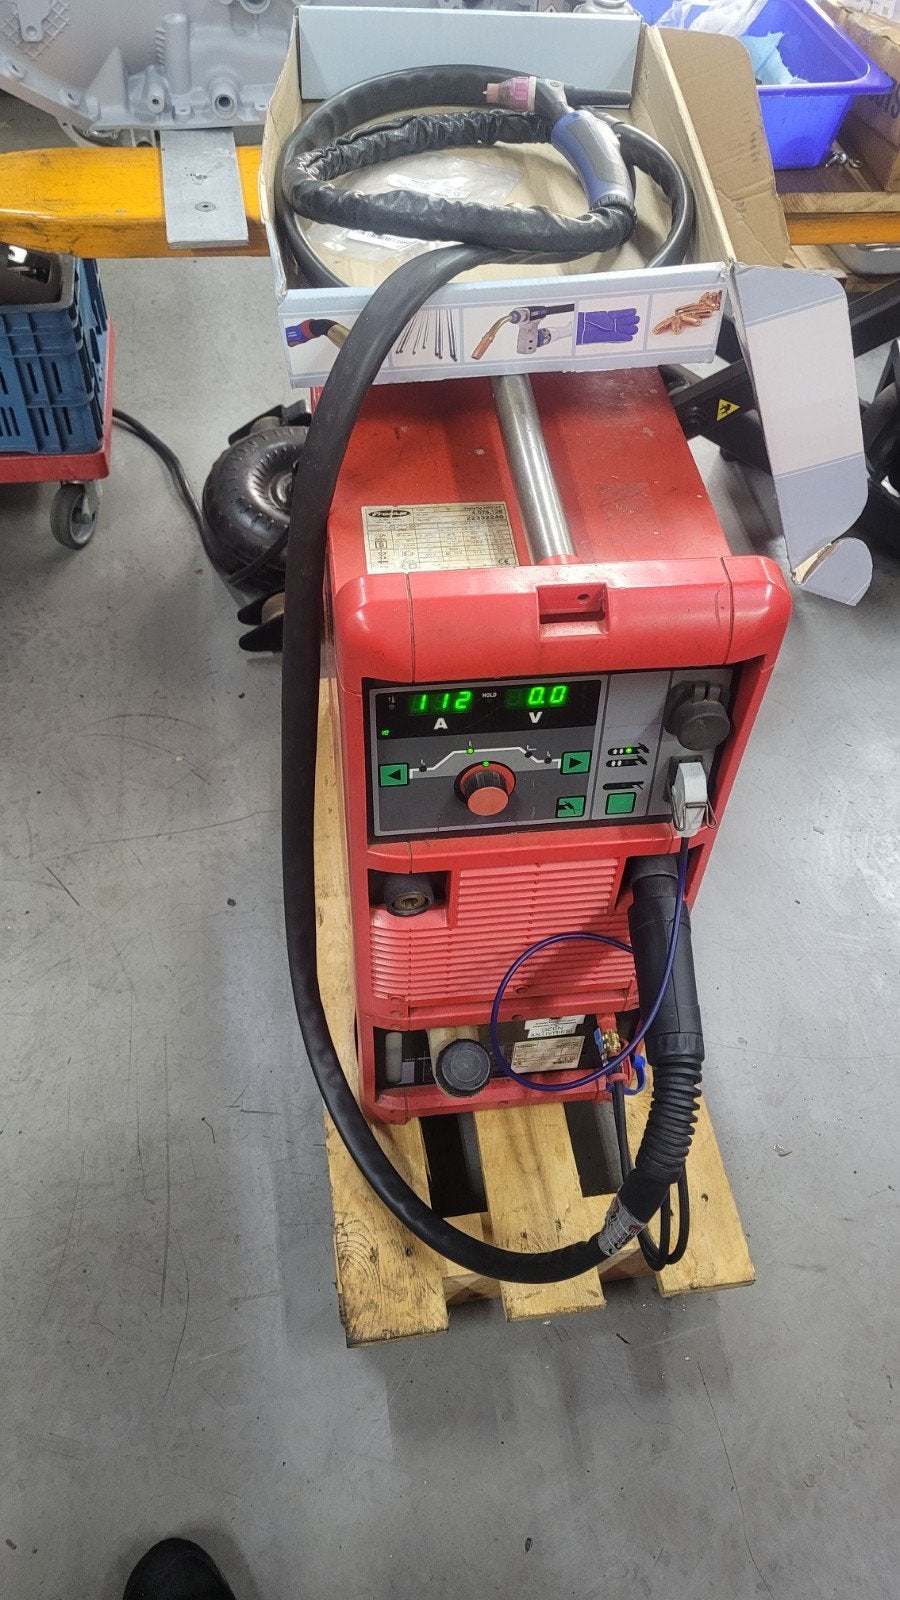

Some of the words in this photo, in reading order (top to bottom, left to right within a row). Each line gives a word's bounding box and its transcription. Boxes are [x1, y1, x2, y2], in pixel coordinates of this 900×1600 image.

[419, 691, 472, 711] 112
[528, 686, 567, 706] 0.0
[433, 717, 448, 730] A
[529, 711, 543, 724] V
